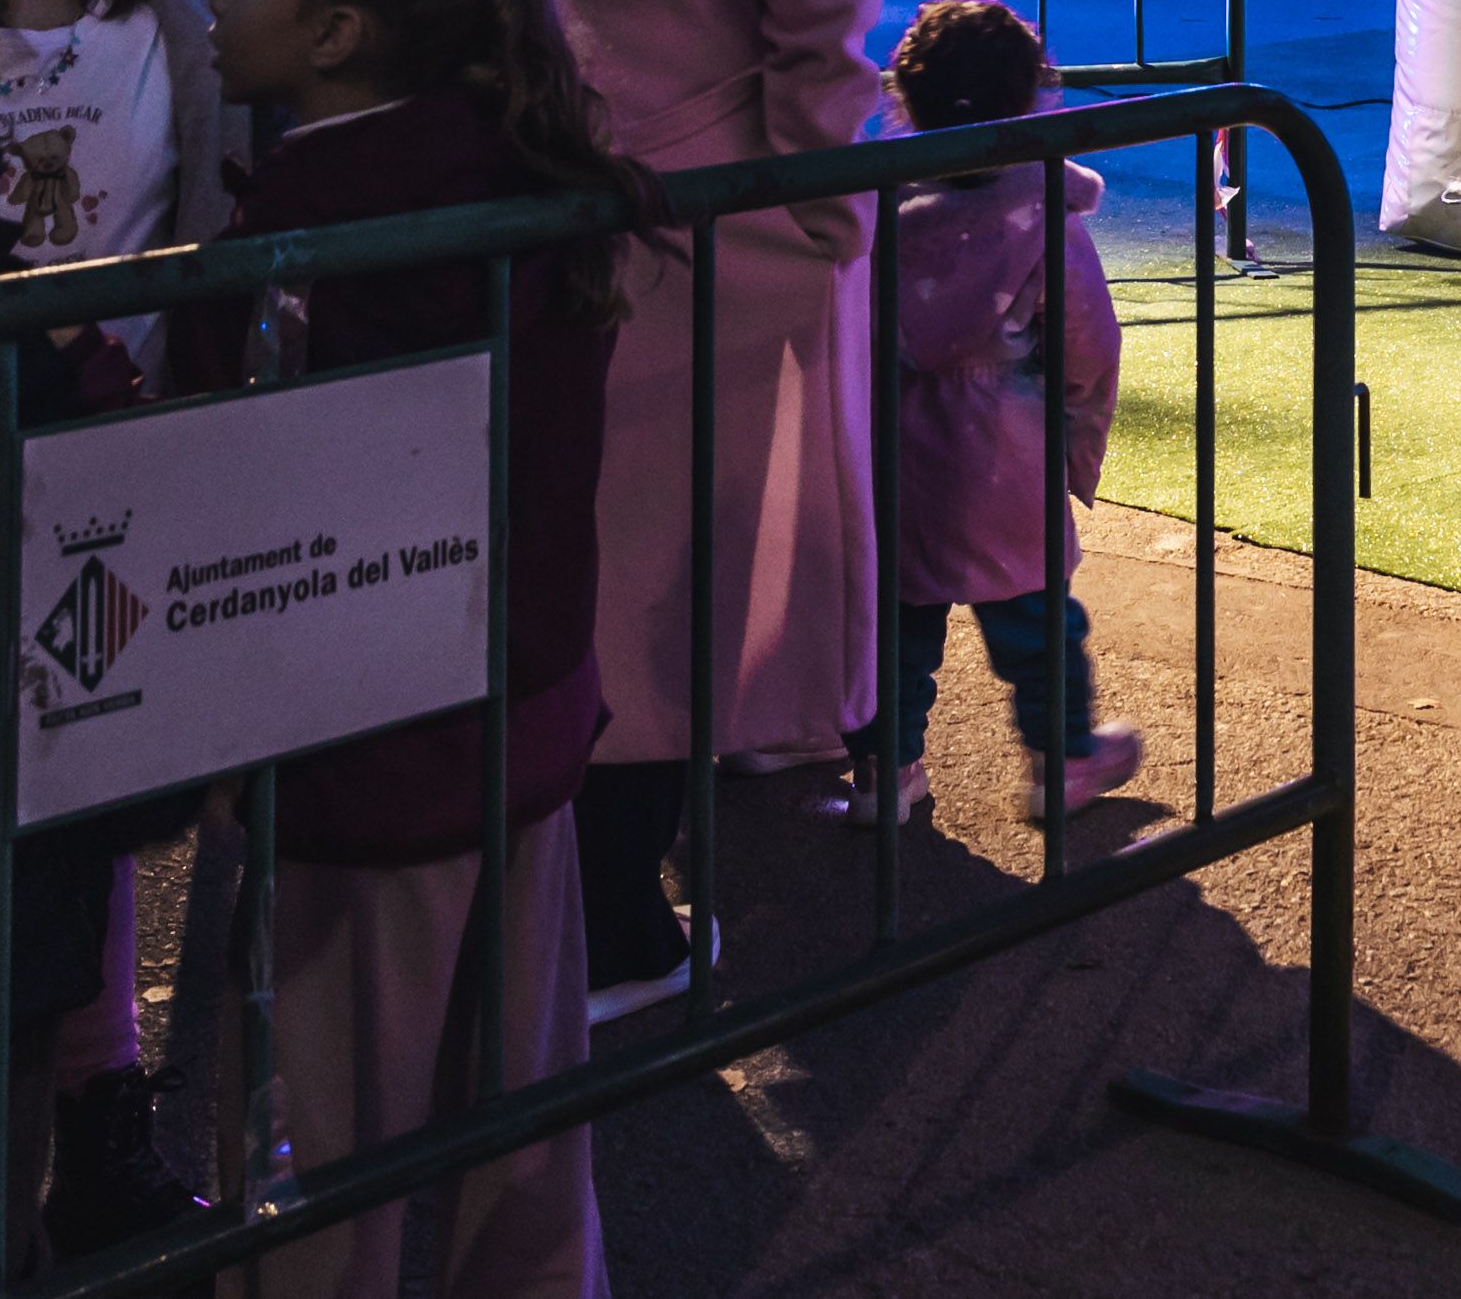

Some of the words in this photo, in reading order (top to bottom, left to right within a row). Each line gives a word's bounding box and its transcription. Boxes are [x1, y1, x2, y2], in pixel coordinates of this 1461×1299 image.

[166, 539, 302, 595] Ajuntament
[309, 532, 337, 558] de
[166, 568, 337, 633] Cerdanyola
[347, 553, 390, 590] del
[399, 536, 480, 578] Vallès
